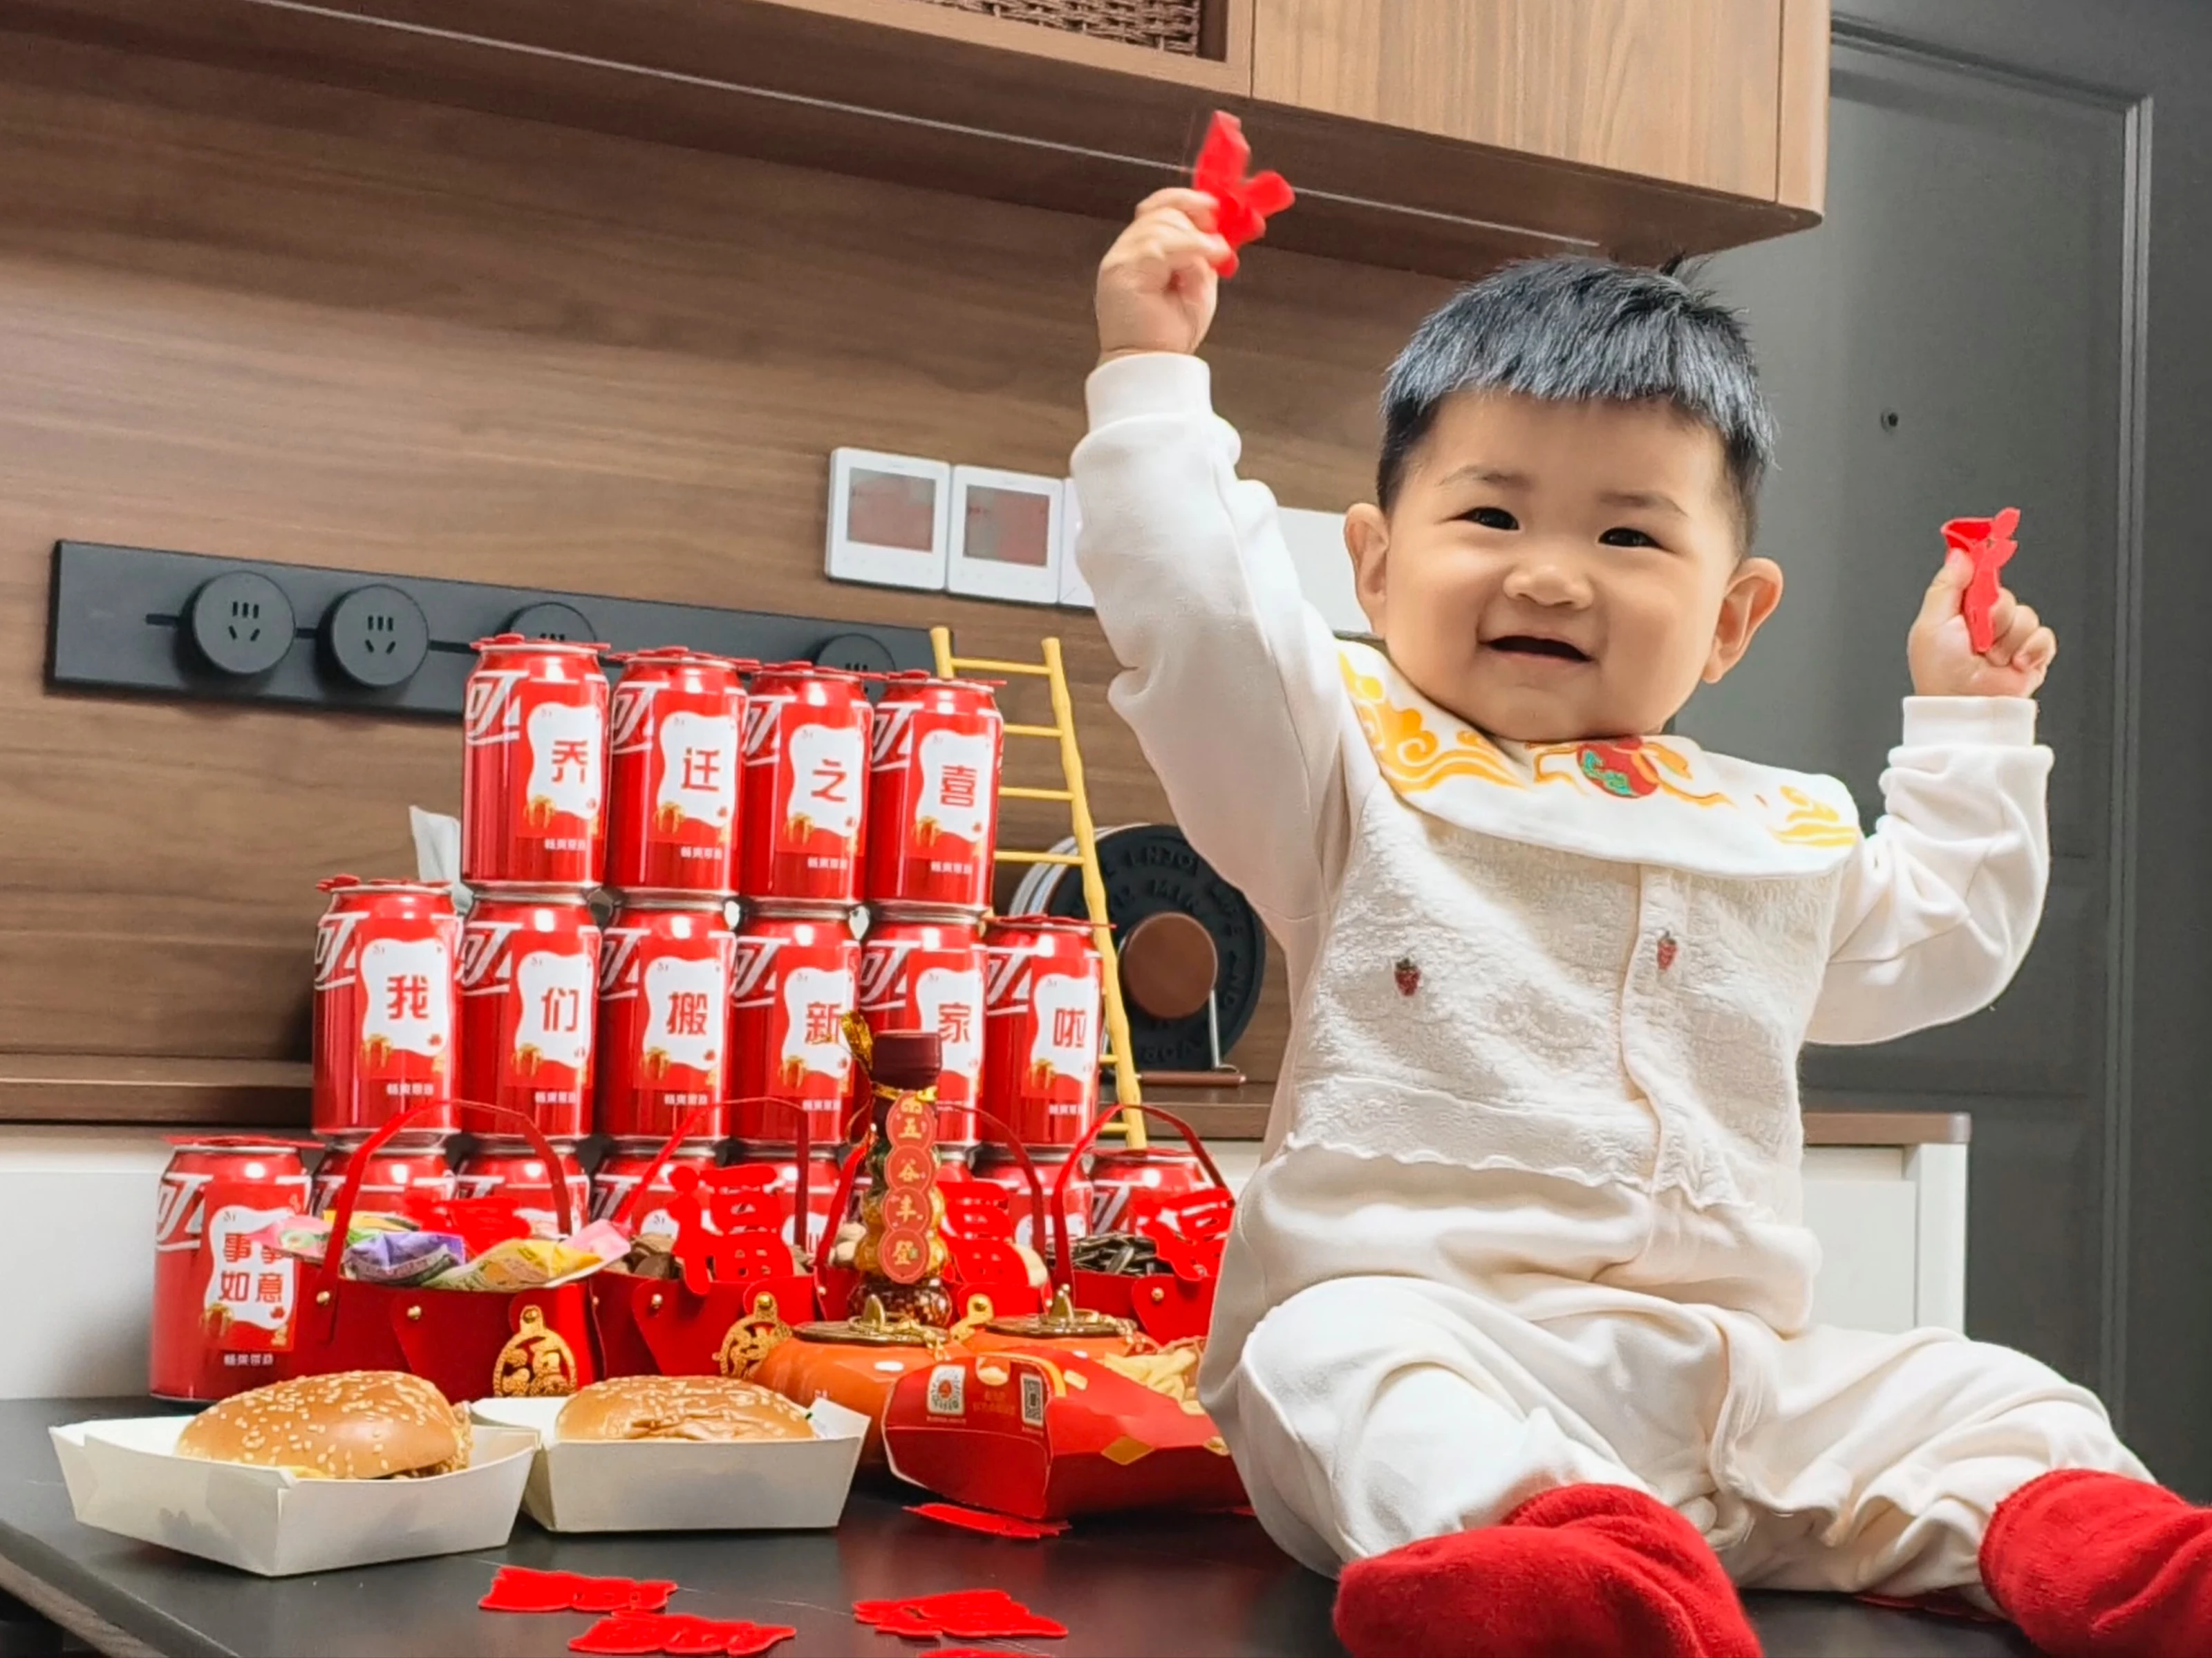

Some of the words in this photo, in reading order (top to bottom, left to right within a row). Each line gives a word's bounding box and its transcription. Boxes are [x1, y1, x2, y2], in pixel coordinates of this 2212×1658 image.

[552, 739, 588, 784] 乔
[681, 747, 720, 792] 迁
[811, 759, 847, 802] 之
[940, 765, 977, 807] 喜
[387, 975, 429, 1020] 我
[541, 987, 580, 1032] 们
[666, 992, 708, 1035] 搬
[805, 1001, 842, 1044] 新
[938, 1003, 971, 1044] 家
[1053, 1008, 1087, 1048] 啦
[218, 1270, 284, 1303] 如意
